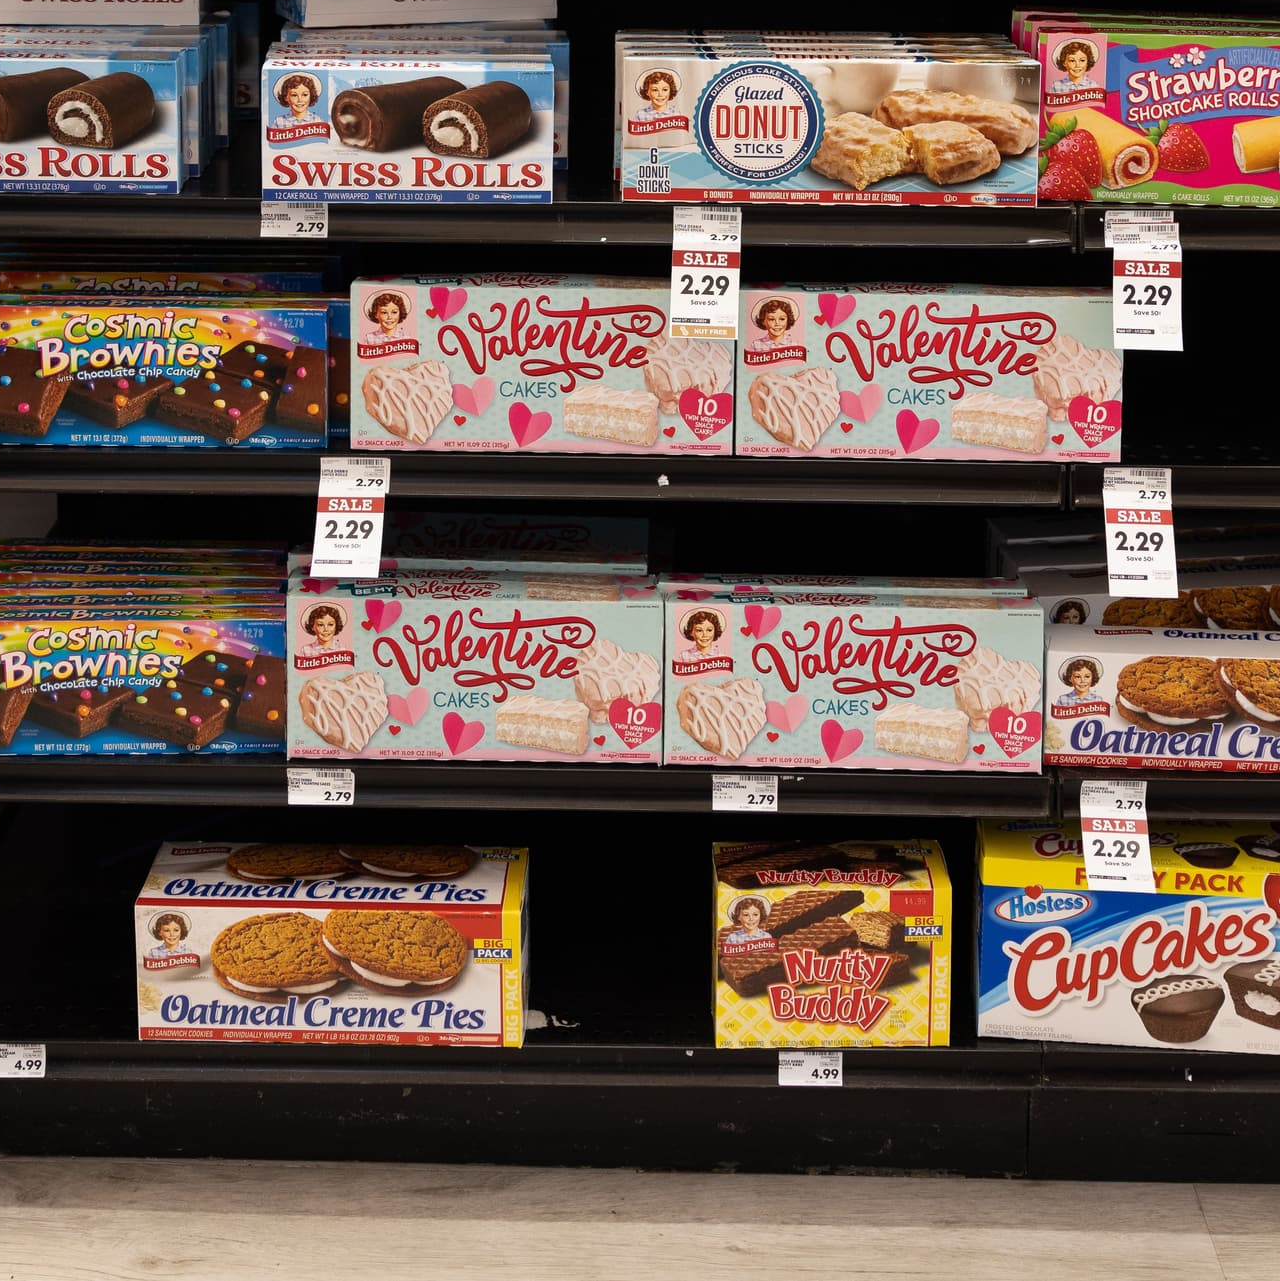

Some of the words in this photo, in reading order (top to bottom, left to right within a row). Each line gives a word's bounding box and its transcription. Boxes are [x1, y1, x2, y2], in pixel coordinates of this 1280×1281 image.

[735, 84, 784, 102] Glazed
[1128, 94, 1222, 122] SHORTCAKE
[1226, 90, 1280, 111] ROLLS
[716, 104, 803, 141] DONUT
[734, 143, 784, 155] STICKS
[38, 148, 170, 179] ROLLS
[750, 191, 788, 200] INDIVIDUALLY
[790, 192, 820, 201] WRAPPED
[38, 338, 220, 376] Brownies
[483, 939, 505, 948] BIG
[478, 949, 509, 959] PACK
[783, 950, 888, 990] Nutty
[770, 982, 890, 1029] Buddy
[14, 1060, 42, 1071] 4.99
[811, 1068, 839, 1079] 4.99
